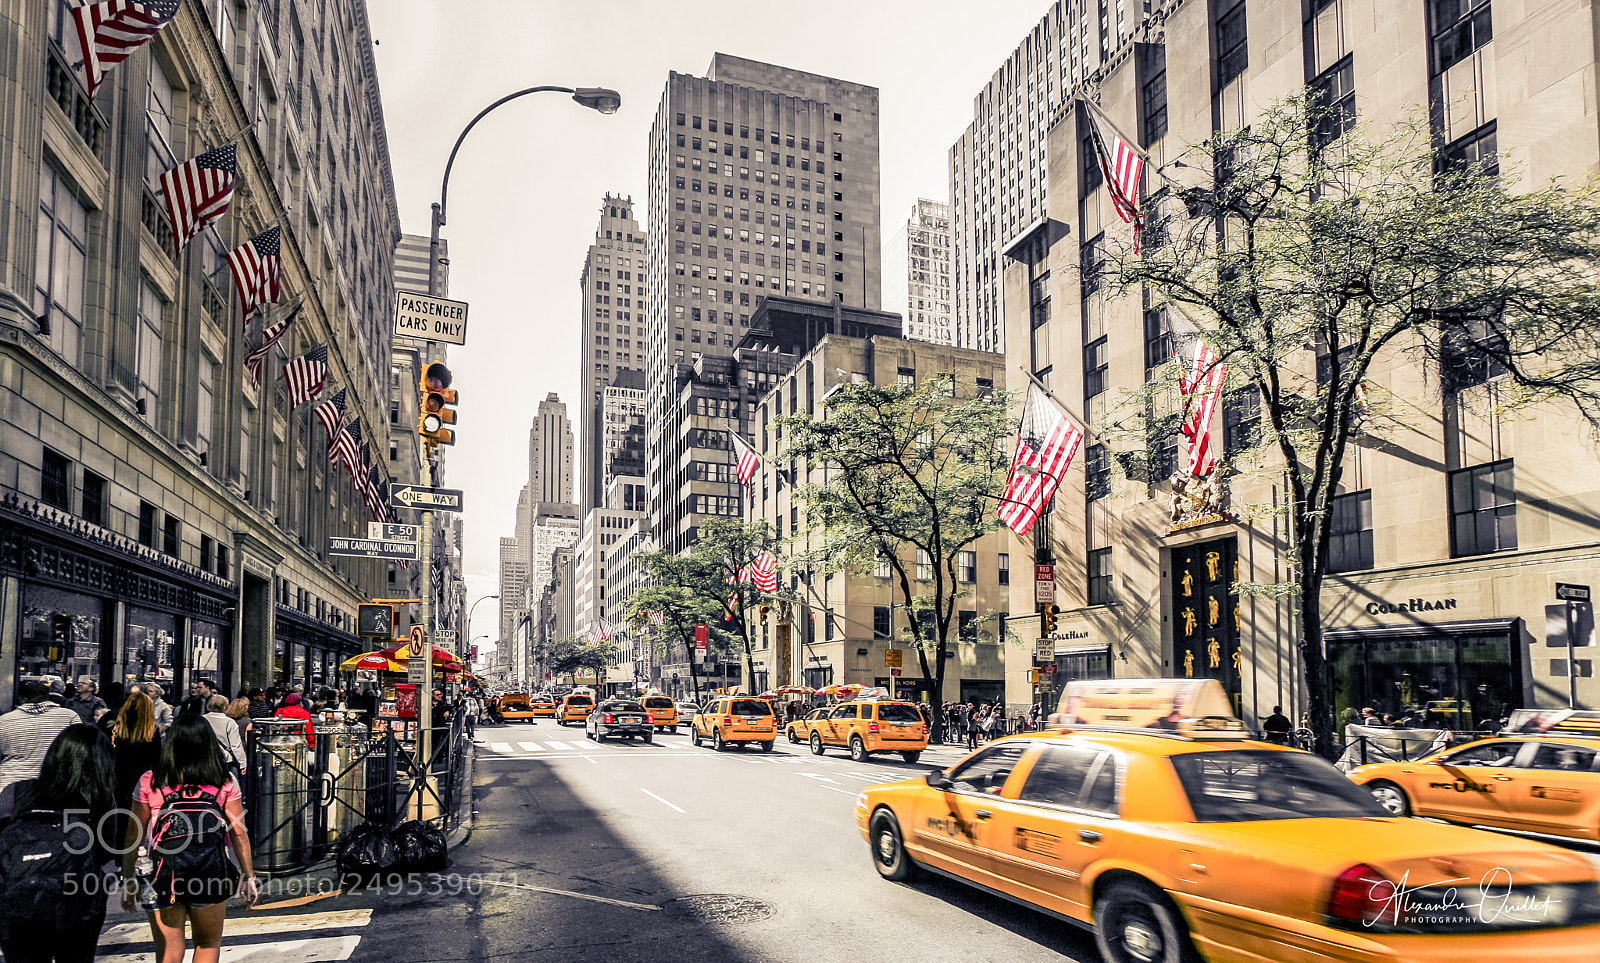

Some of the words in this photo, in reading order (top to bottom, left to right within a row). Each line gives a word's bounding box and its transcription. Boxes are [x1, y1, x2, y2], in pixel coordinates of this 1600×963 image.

[401, 298, 463, 320] PASSENGER
[399, 315, 428, 331] CARS
[434, 320, 462, 336] ONLY
[401, 491, 423, 502] ONE
[432, 494, 455, 505] WAY
[388, 525, 395, 535] E
[399, 526, 413, 536] 50
[330, 539, 349, 549] JOHN
[350, 540, 382, 552] CARDINAL
[383, 542, 415, 554] O'CONNOR
[435, 630, 455, 638] STOP
